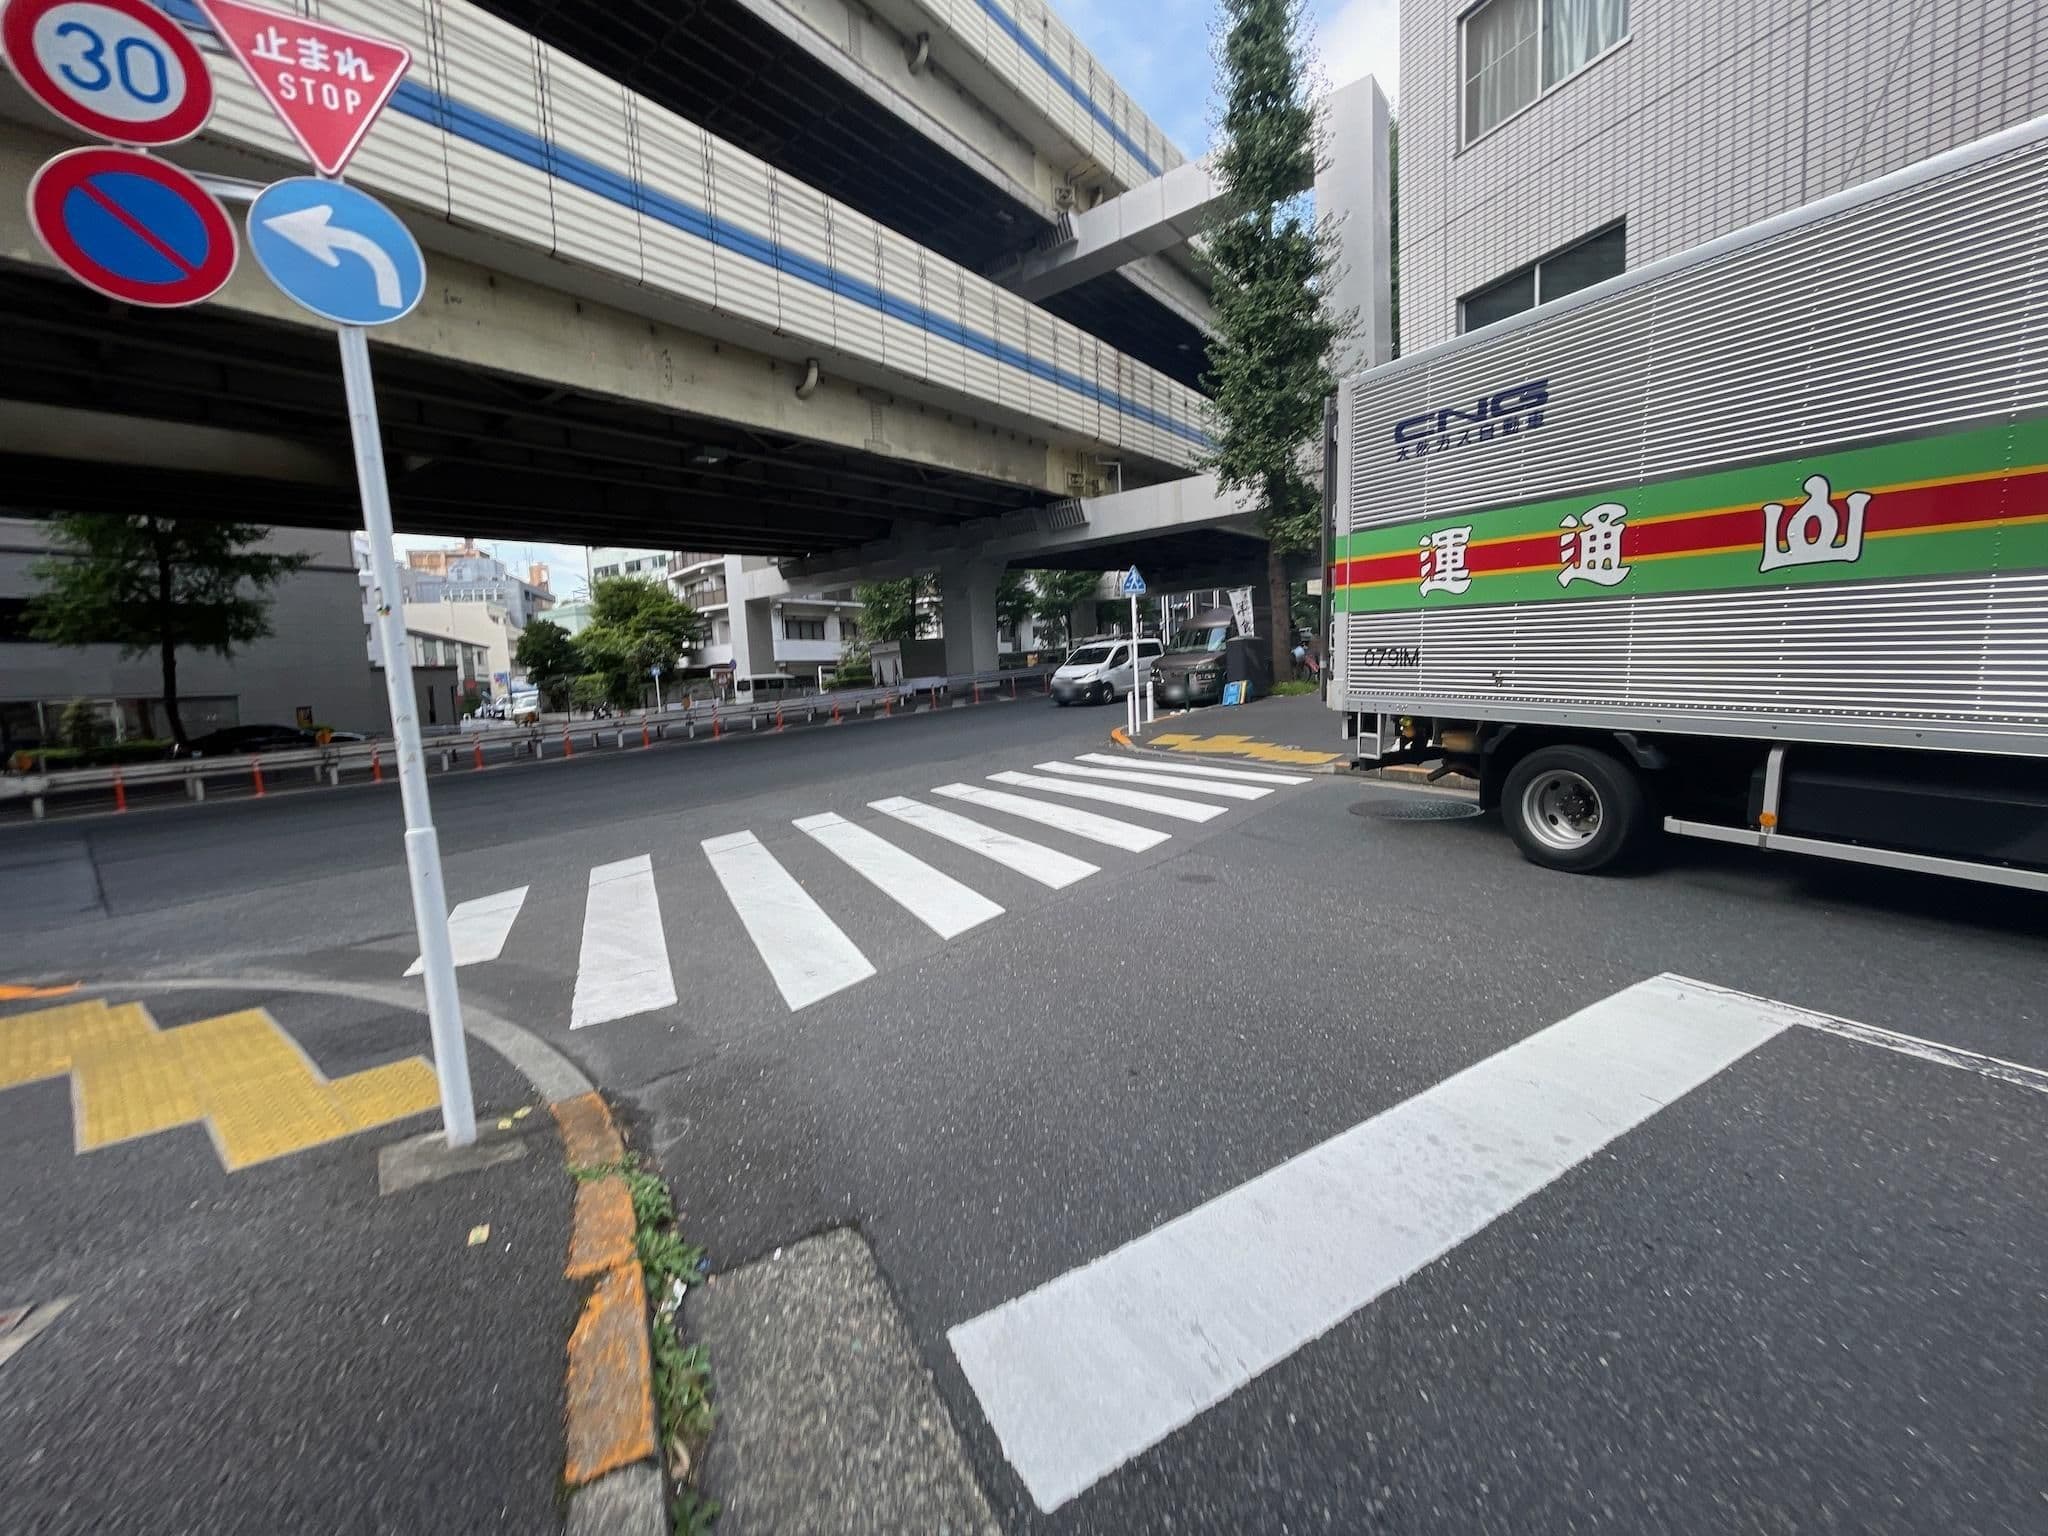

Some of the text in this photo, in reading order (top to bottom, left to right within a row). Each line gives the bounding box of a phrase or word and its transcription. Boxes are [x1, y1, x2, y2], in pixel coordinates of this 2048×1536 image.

[57, 22, 169, 104] 30
[251, 26, 375, 83] 止まれ
[277, 72, 361, 115] STOP
[1394, 378, 1549, 443] CNG
